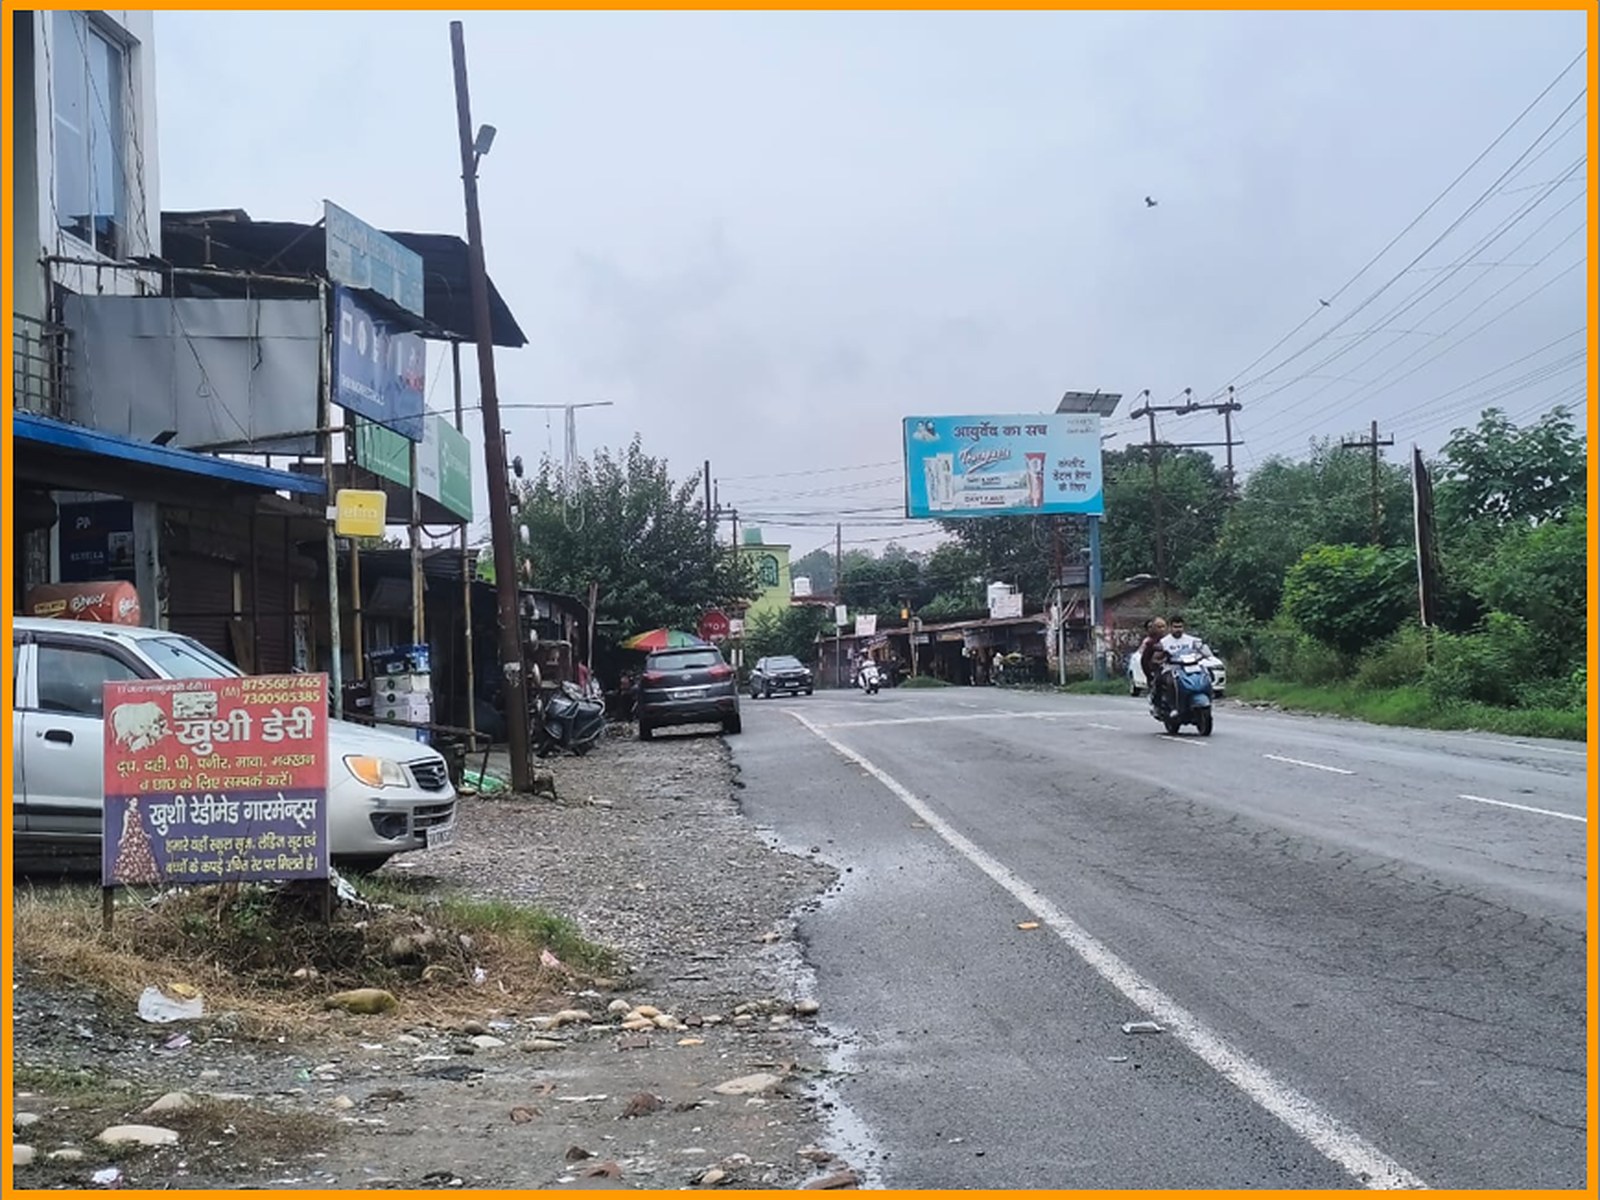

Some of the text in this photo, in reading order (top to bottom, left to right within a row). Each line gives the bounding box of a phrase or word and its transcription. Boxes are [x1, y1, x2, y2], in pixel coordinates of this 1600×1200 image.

[954, 422, 1048, 441] आयुर्वेद का सच
[242, 677, 321, 690] 8755687465
[242, 691, 320, 704] 7300505385
[176, 706, 315, 755] खुशी डेरी
[152, 778, 177, 791] छाछ
[179, 775, 193, 790] के
[196, 772, 220, 789] लिए
[149, 795, 187, 835] खुशी
[189, 793, 240, 825] रेडीमेड
[188, 857, 199, 873] के
